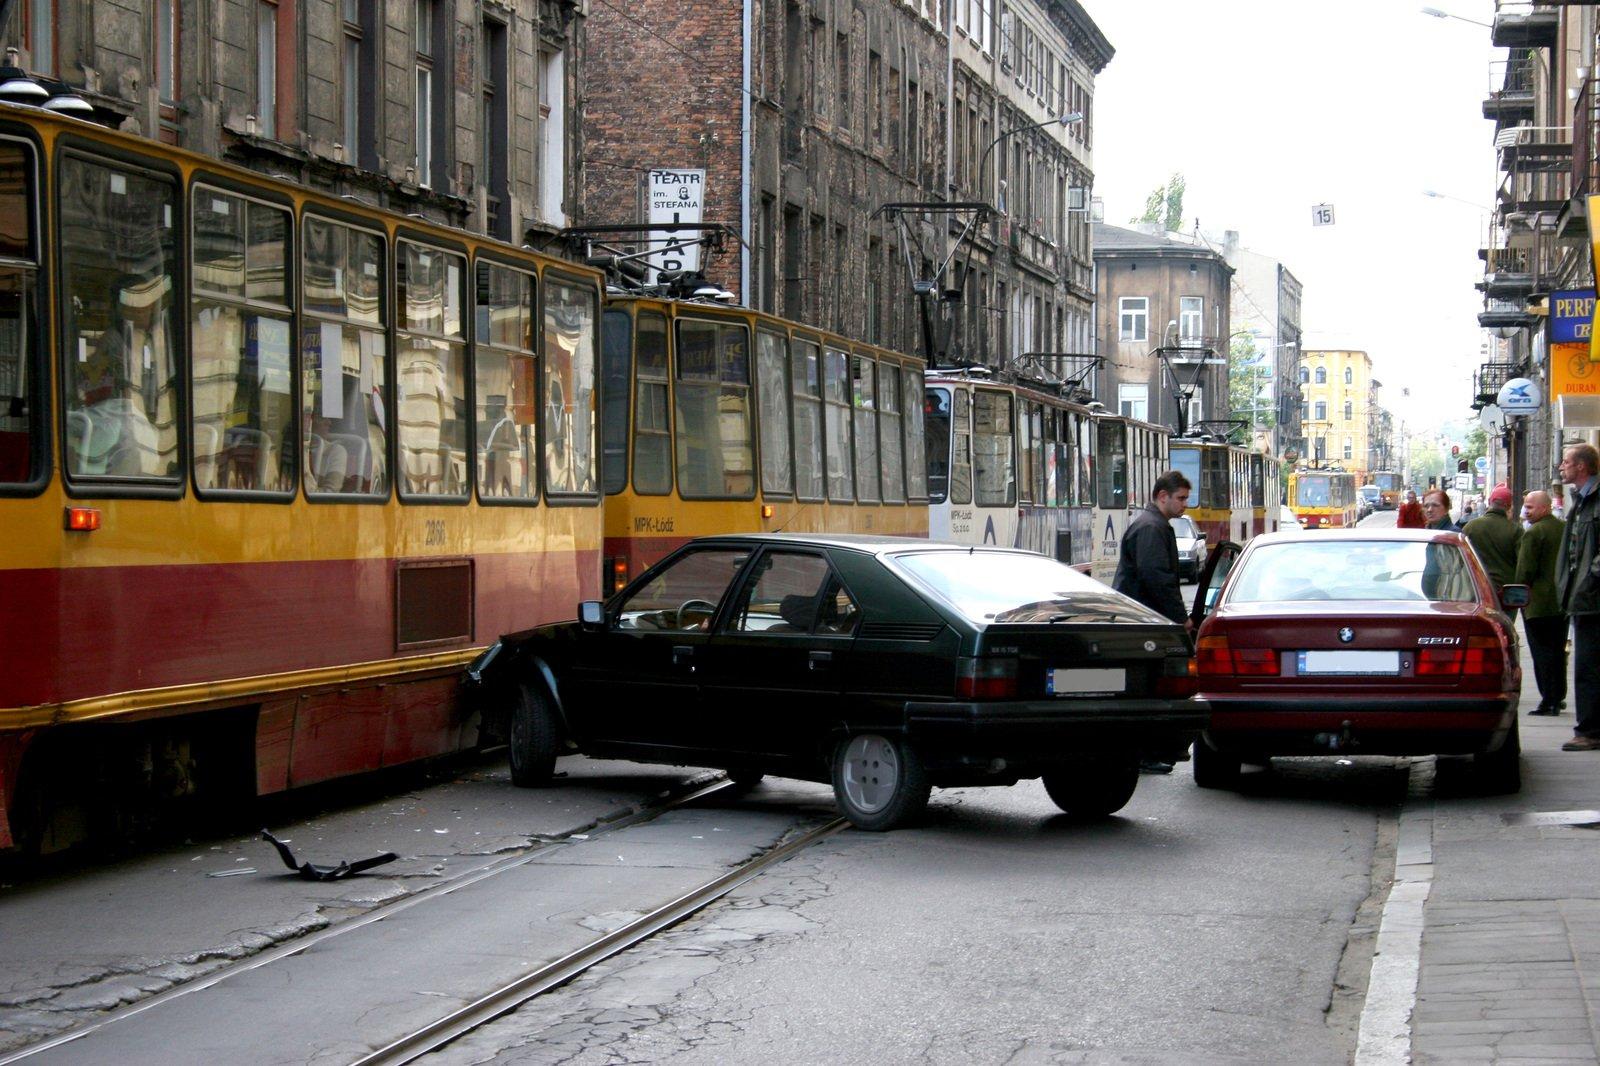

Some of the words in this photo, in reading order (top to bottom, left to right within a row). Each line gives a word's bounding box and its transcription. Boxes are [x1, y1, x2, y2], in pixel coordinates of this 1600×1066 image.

[652, 174, 700, 184] TEATR
[1316, 209, 1331, 224] 15
[1556, 298, 1596, 318] PERF
[1566, 383, 1597, 393] DURAN
